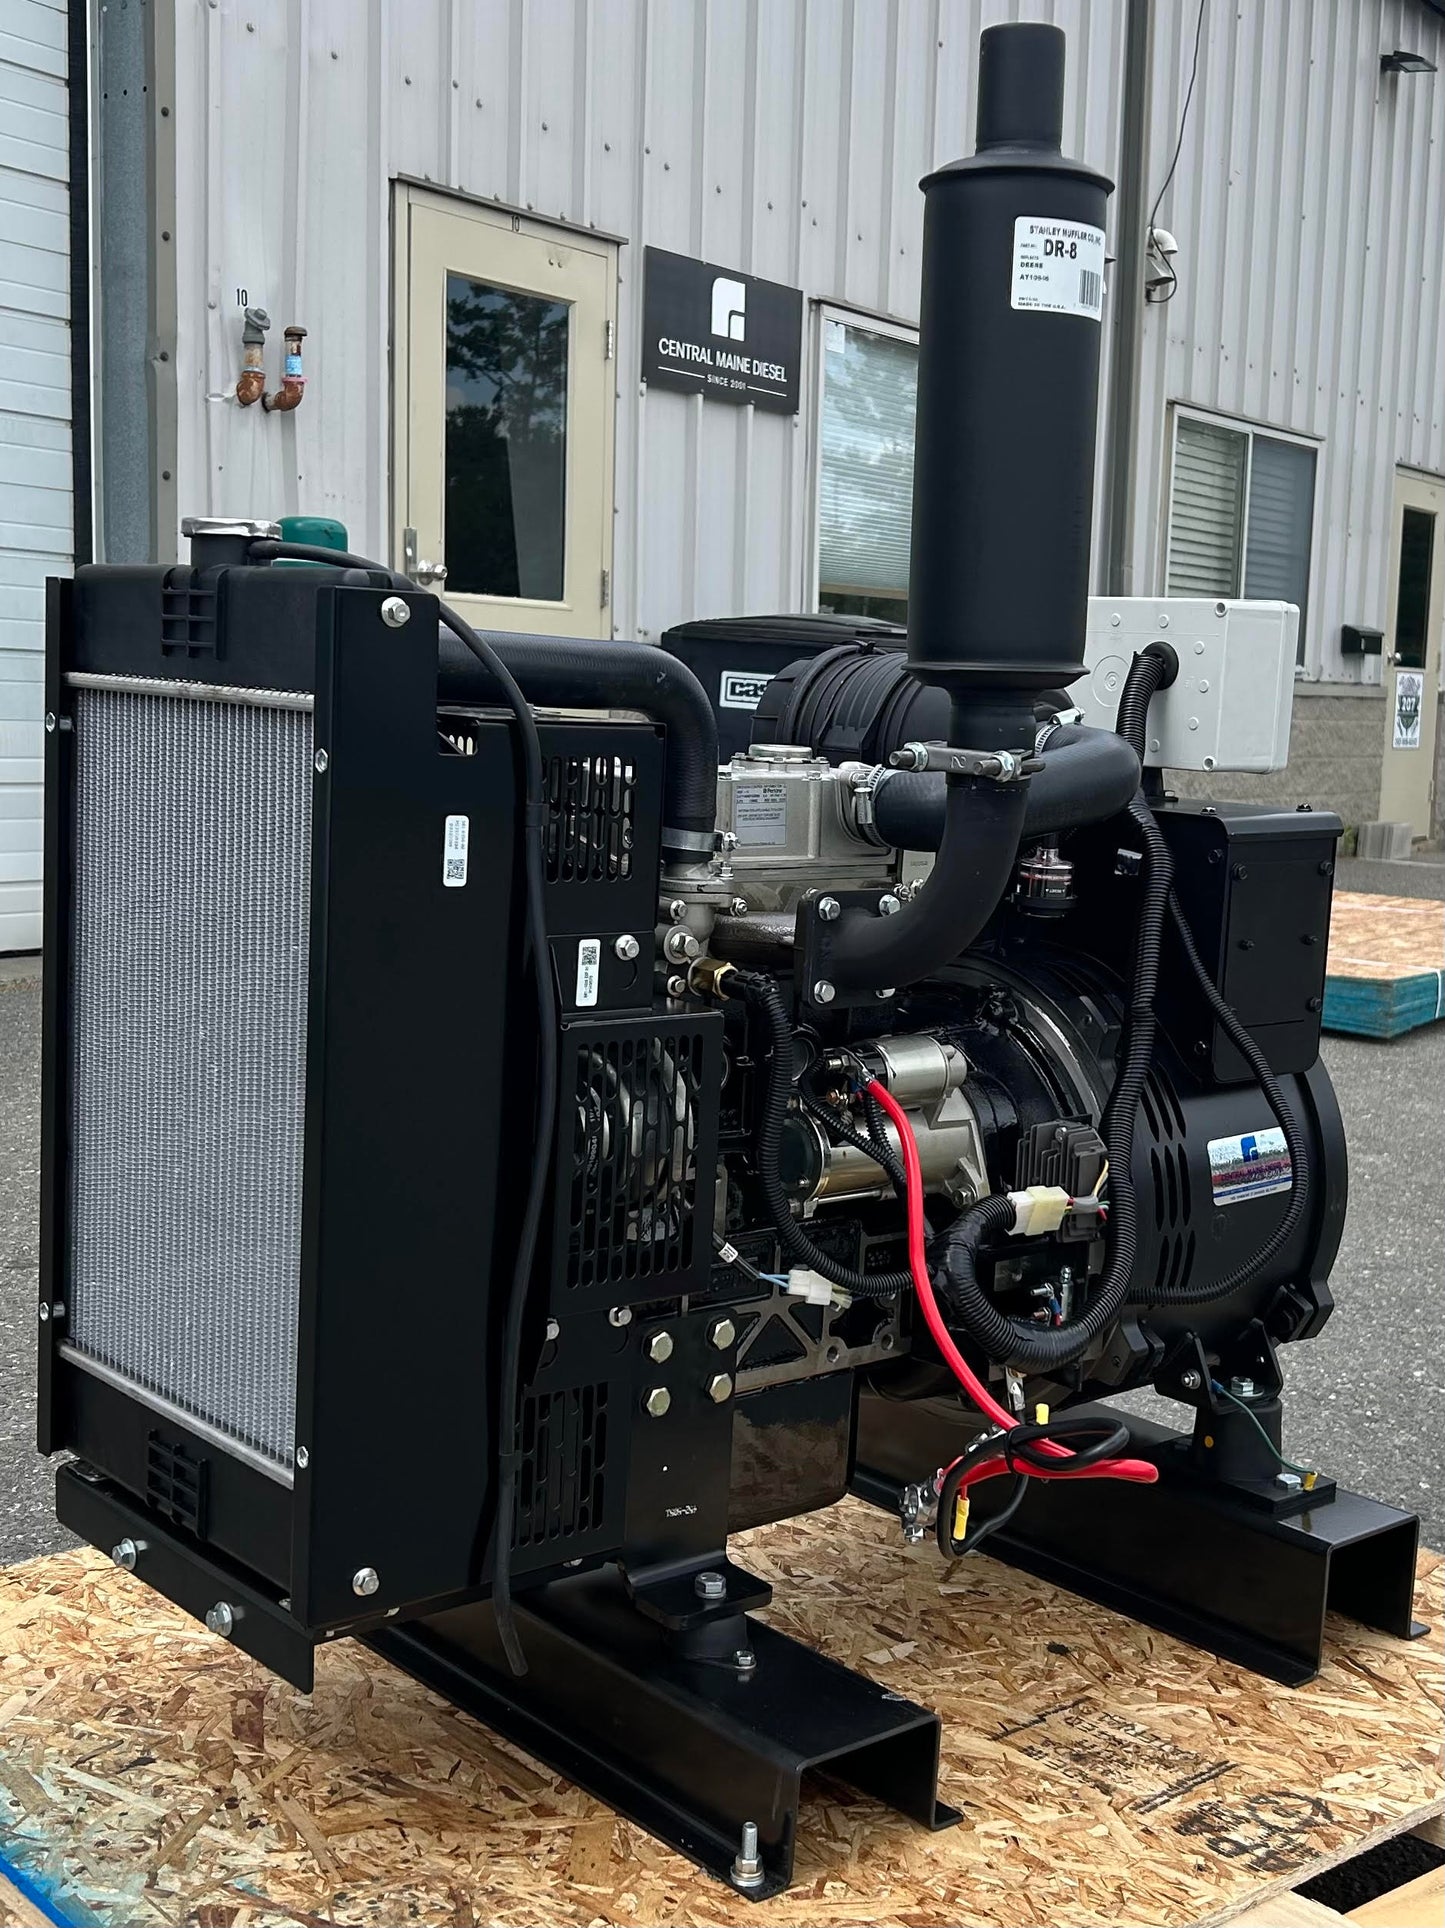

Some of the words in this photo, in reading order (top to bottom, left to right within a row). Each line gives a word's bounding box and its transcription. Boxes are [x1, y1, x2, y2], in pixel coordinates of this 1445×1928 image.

[1029, 225, 1061, 237] STANLEY
[1062, 228, 1087, 240] MUFFLER
[1044, 239, 1077, 259] DR-8
[236, 288, 248, 307] 10
[658, 337, 713, 365] CENTRAL
[715, 351, 751, 374] MAINE
[753, 360, 788, 382] DIESEL
[707, 374, 728, 387] SINCE
[1401, 696, 1416, 712] 207
